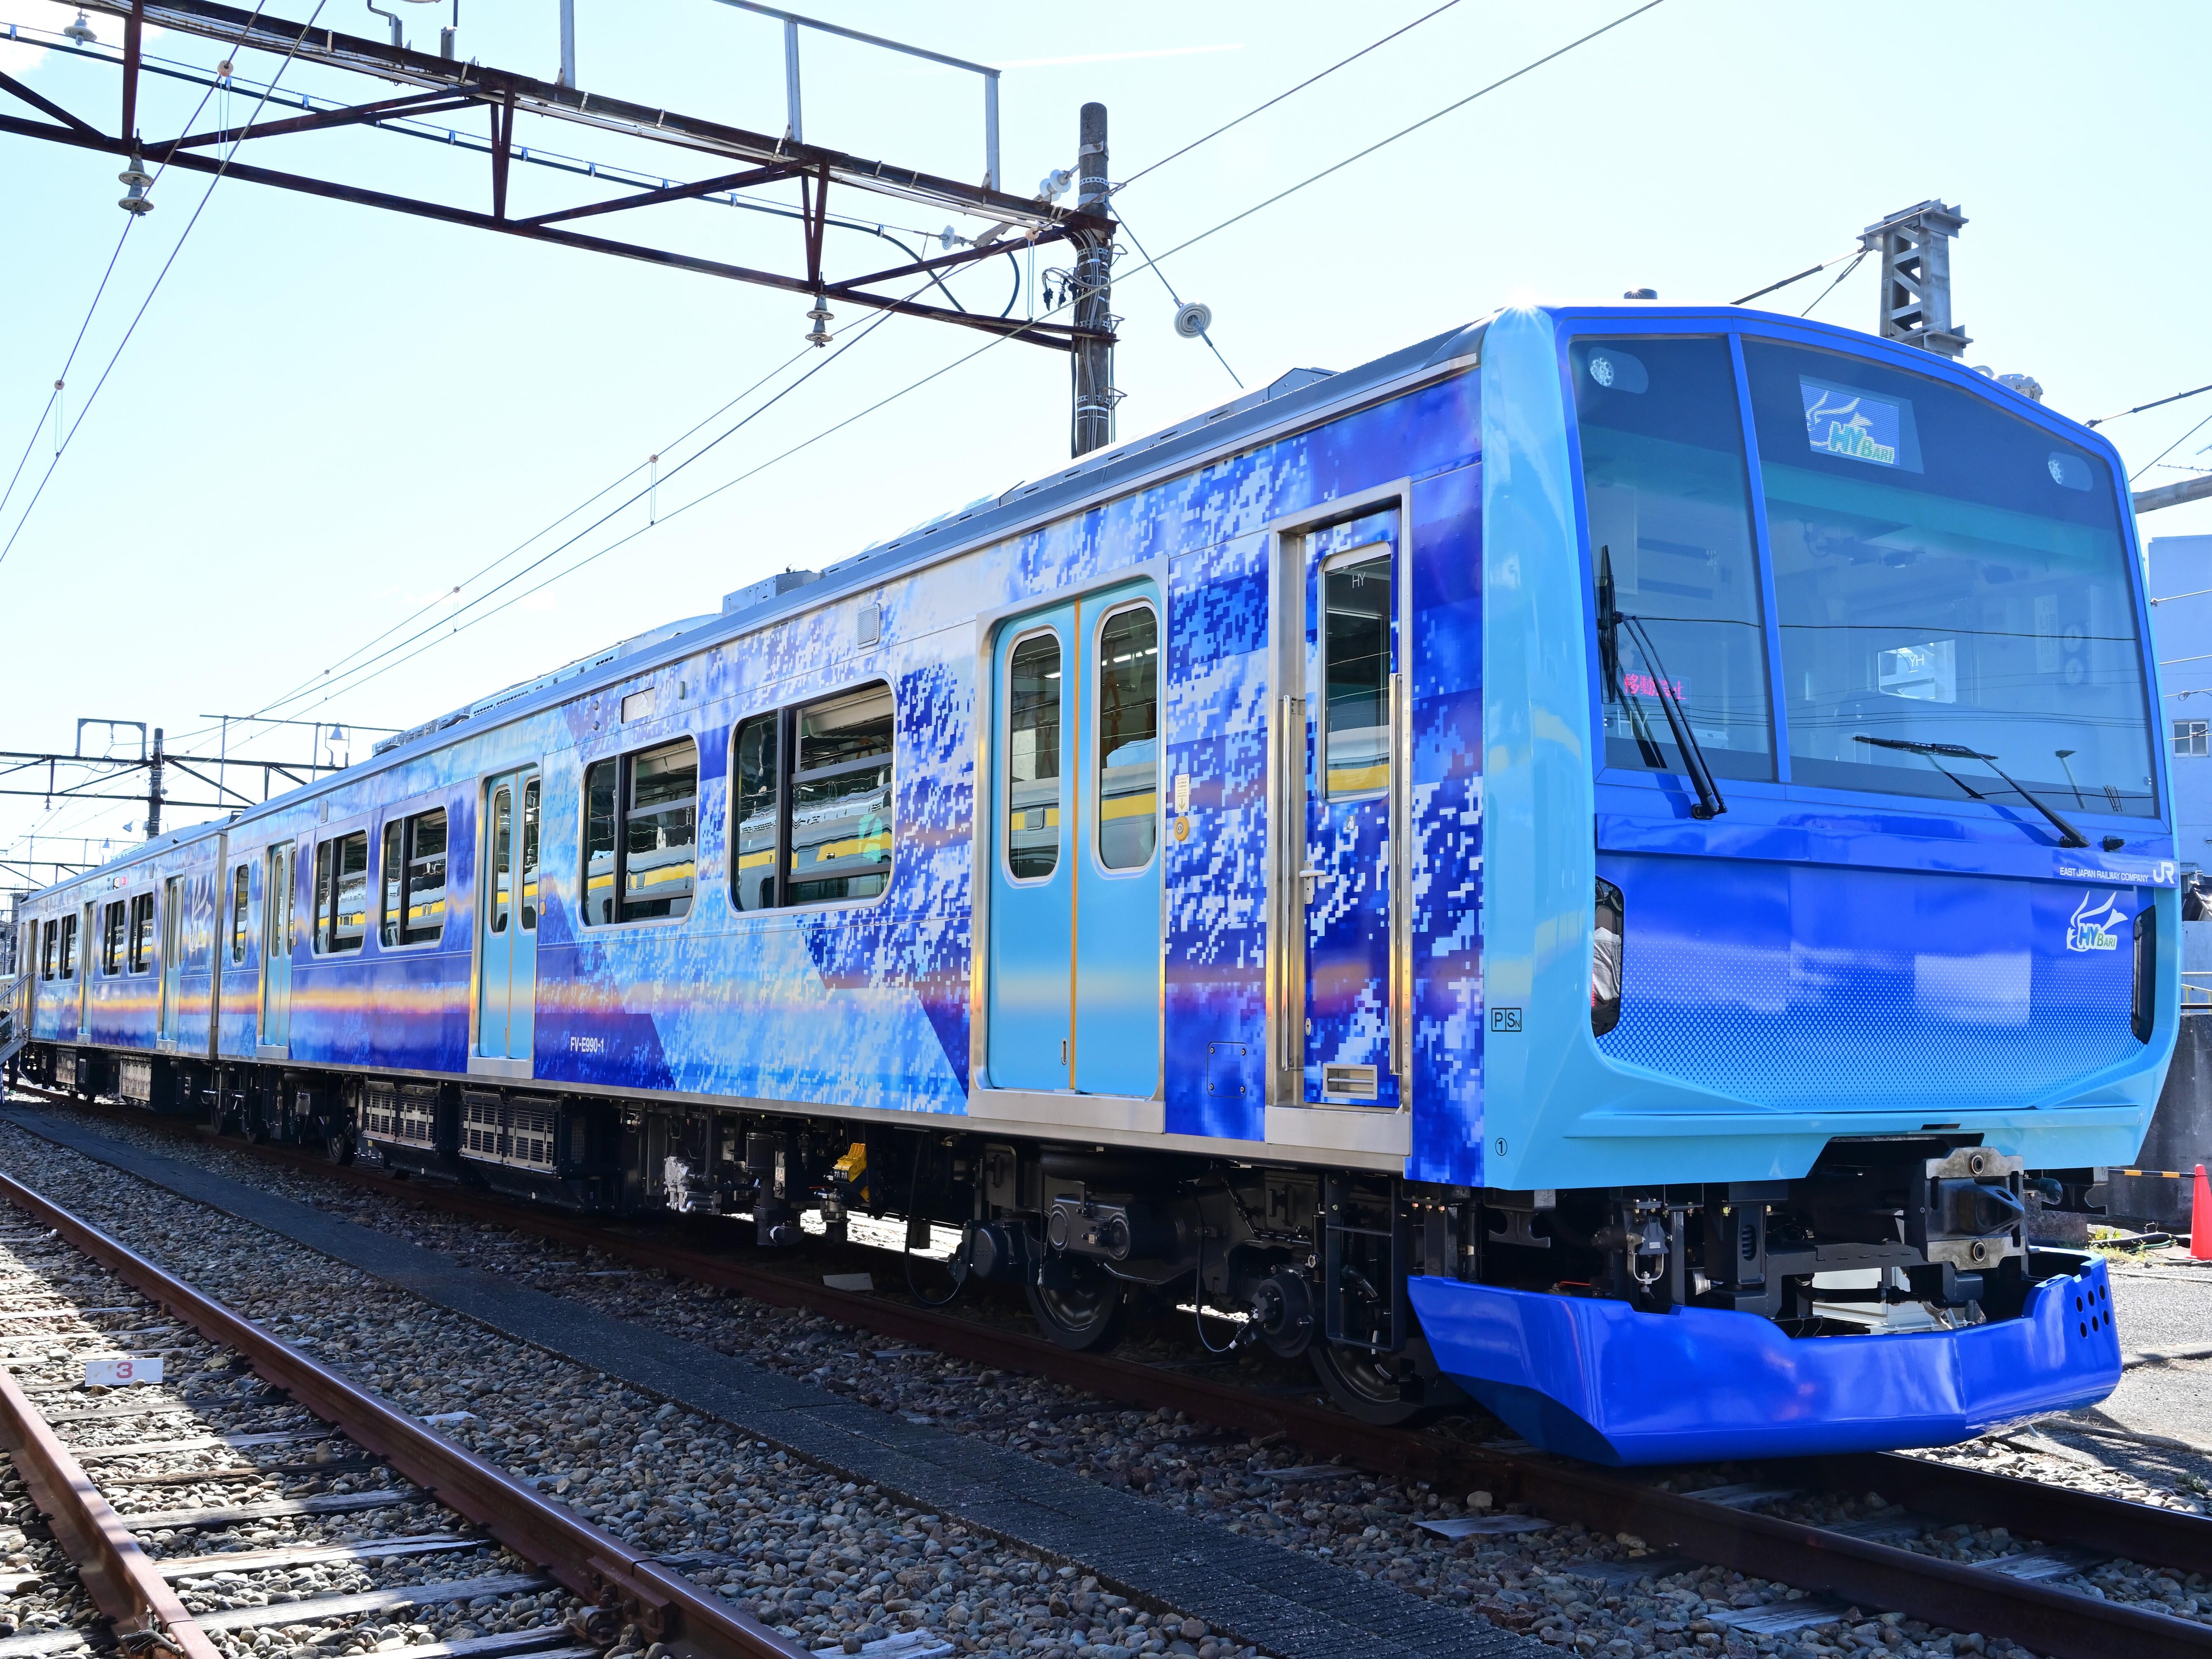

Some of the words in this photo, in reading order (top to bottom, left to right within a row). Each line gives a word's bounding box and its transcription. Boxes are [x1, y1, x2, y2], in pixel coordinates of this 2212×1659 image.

[1352, 572, 1366, 588] HY
[1617, 709, 1649, 737] HY
[2060, 867, 2076, 876] EAST
[2076, 869, 2096, 878] JAPAN
[2097, 870, 2120, 880] RAILWAY
[2121, 873, 2149, 882] COMPANY
[2153, 862, 2174, 884] JR
[570, 1036, 604, 1053] FV-E990-1
[116, 1362, 133, 1379] 3
